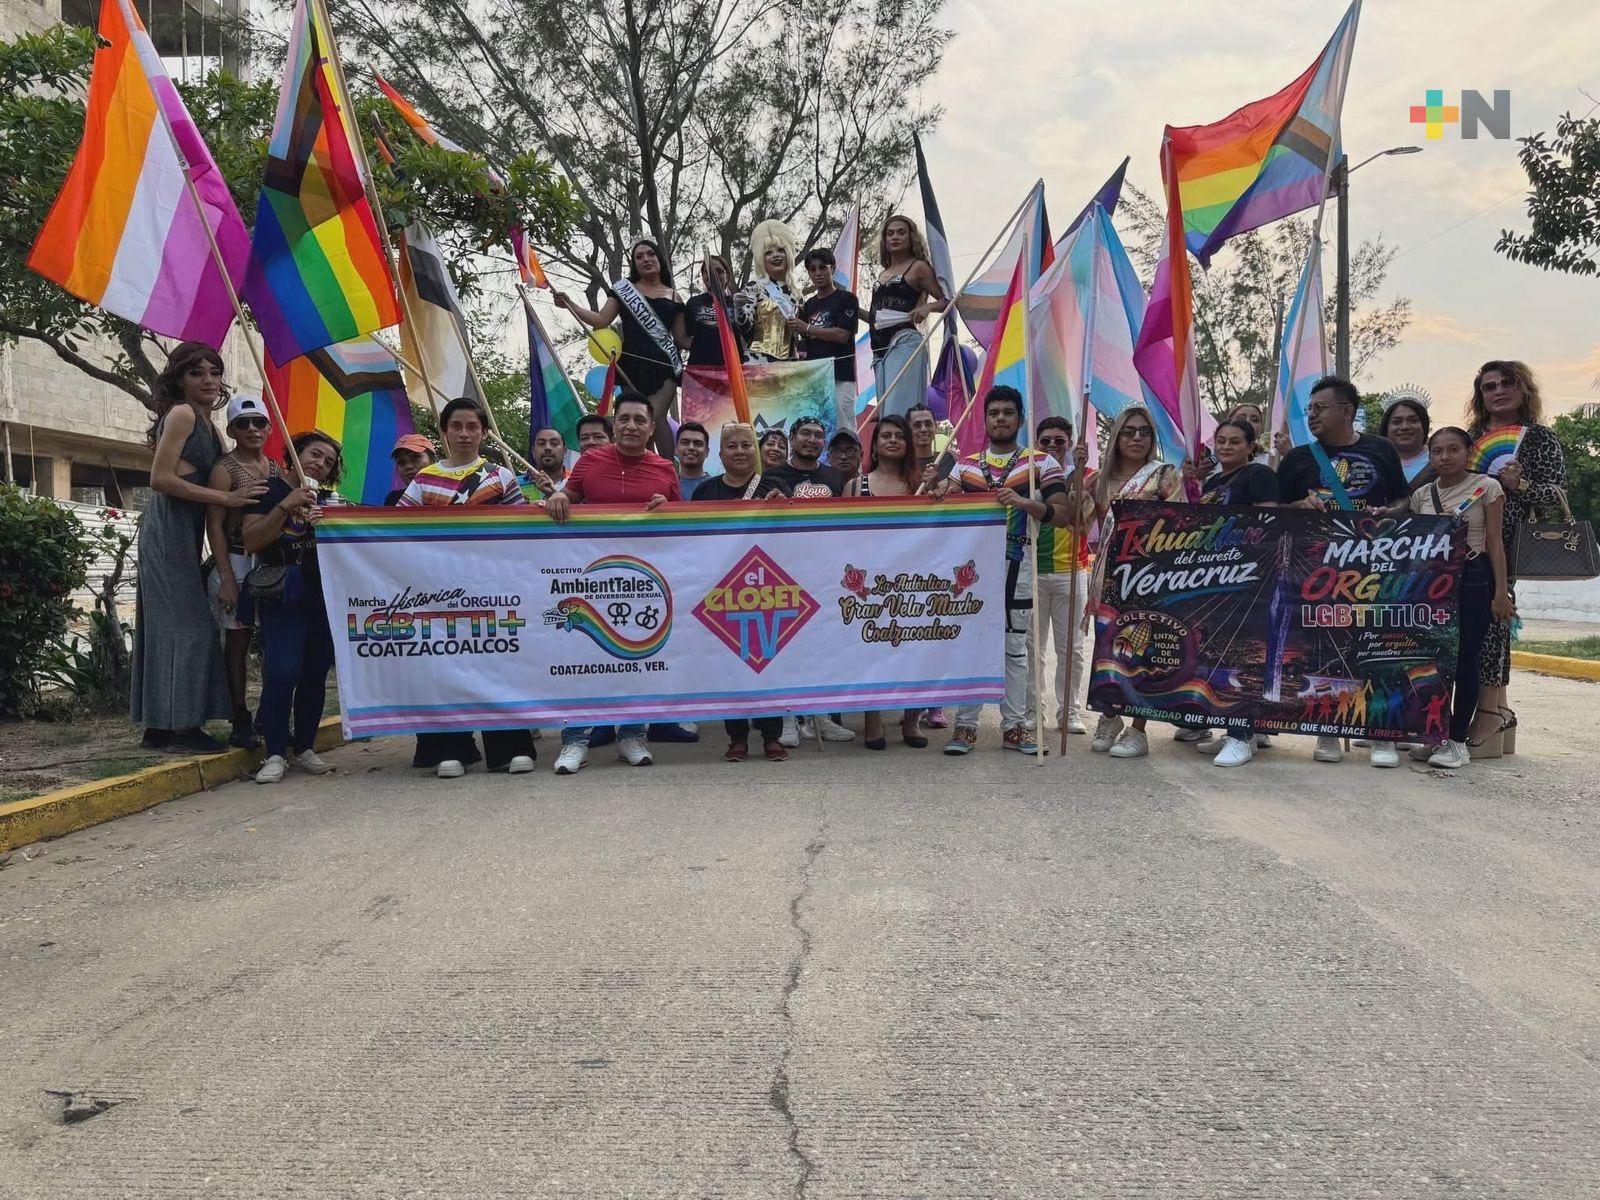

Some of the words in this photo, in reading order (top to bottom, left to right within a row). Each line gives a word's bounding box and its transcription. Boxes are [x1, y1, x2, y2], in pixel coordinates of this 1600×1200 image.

[618, 283, 657, 330] MAJESTAD
[796, 482, 829, 498] Love
[1174, 552, 1195, 565] del
[1198, 548, 1244, 563] sureste
[1322, 534, 1454, 569] MARCHA
[744, 567, 765, 586] el
[1370, 562, 1397, 572] DEL
[550, 577, 654, 594] AmbientTales
[871, 575, 891, 596] La
[1112, 561, 1262, 601] Veracruz
[1301, 566, 1454, 602] ORGULLO
[348, 597, 386, 607] Marcha
[461, 595, 521, 608] ORGULLO
[705, 585, 801, 611] CLOSET
[838, 596, 884, 625] Gran
[884, 594, 925, 617] Vela
[926, 592, 983, 617] Muxhe
[1301, 603, 1451, 630] LGBTTTIQ+
[862, 618, 961, 647] Coatzacoalcos
[1116, 613, 1188, 637] COLECTIVO
[726, 610, 799, 660] TV
[1153, 633, 1179, 642] ENTRE
[357, 638, 520, 657] COATZACOALCOS
[1154, 642, 1180, 650] HOJAS
[1356, 651, 1371, 659] por
[1367, 642, 1383, 650] por
[550, 662, 642, 675] COATZACOALCOS,
[645, 661, 669, 671] VER.
[1151, 656, 1181, 666] COLOR
[1124, 705, 1182, 721] DIVERSIDAD
[1184, 713, 1204, 724] QUE
[1206, 716, 1226, 726] NOS
[1228, 718, 1250, 728] UNE,
[1254, 719, 1297, 730] ORGULLO
[1300, 722, 1318, 733] QUE
[1320, 725, 1339, 734] NOS
[1341, 727, 1366, 736] HACE
[1368, 729, 1404, 739] LIBRES
